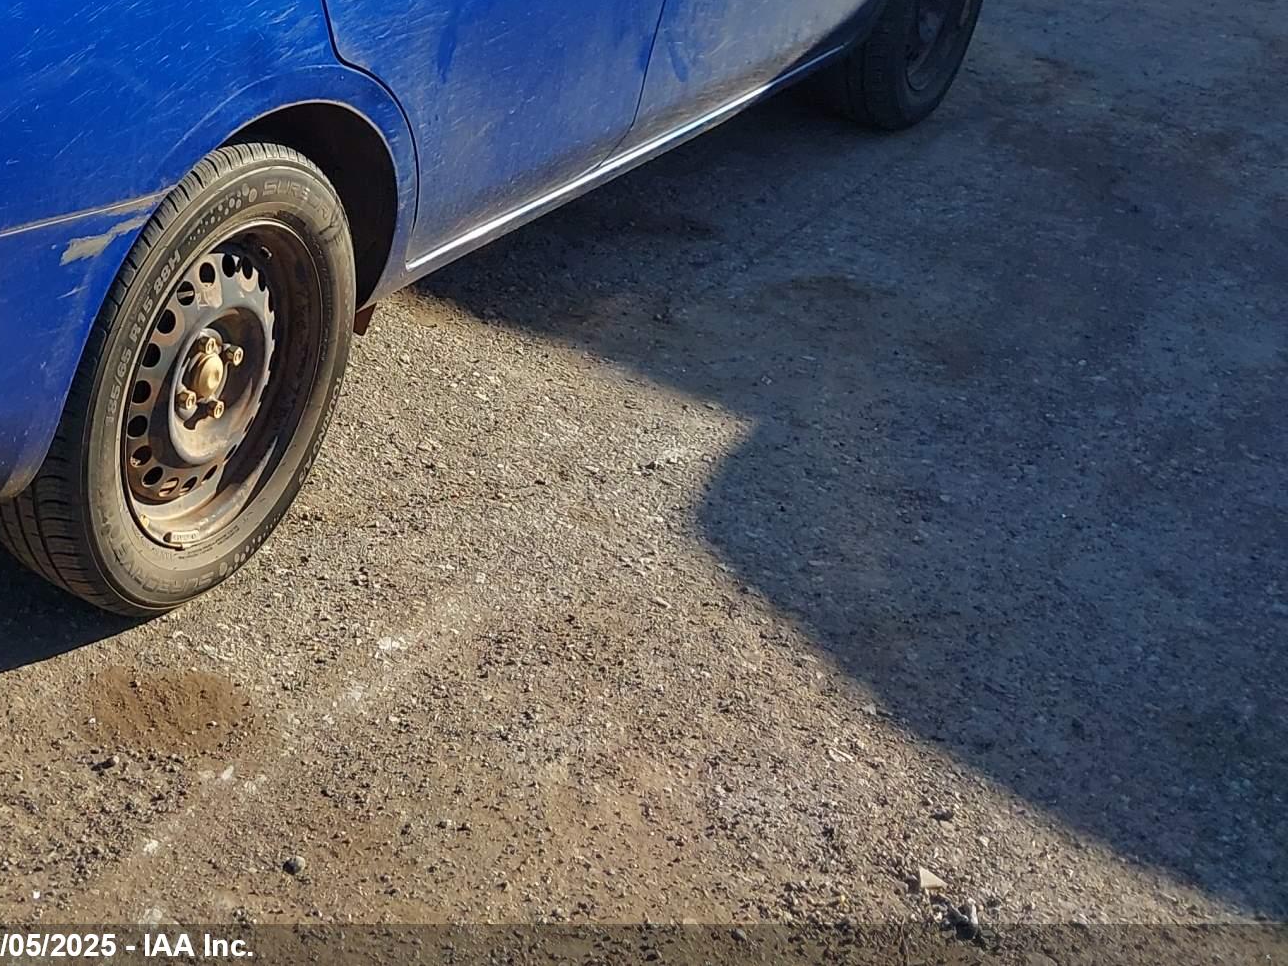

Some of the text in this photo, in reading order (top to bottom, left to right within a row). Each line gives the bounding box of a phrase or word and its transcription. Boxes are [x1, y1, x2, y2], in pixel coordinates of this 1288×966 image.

[105, 248, 182, 428] 185/65 R15 88H
